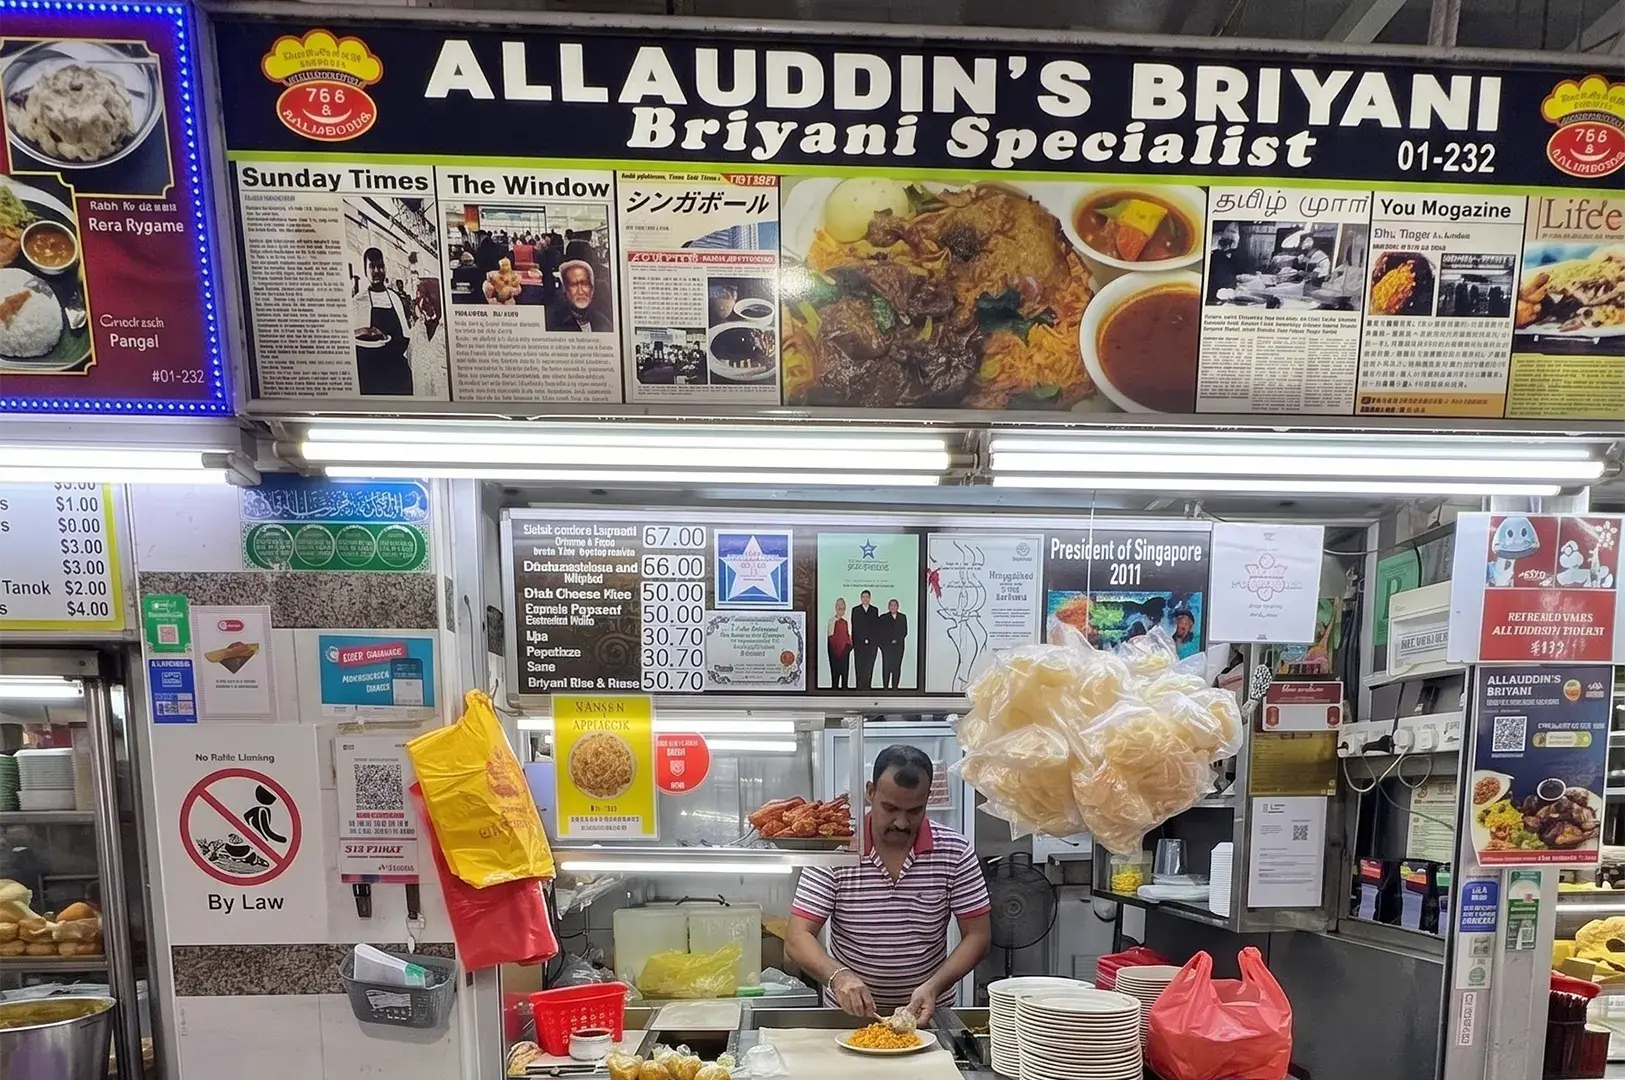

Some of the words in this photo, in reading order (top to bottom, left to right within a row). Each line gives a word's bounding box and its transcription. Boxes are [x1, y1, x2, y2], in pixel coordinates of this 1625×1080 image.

[424, 38, 1091, 119] ALLAUDDIN'S
[1131, 63, 1500, 131] BRIYANI
[628, 106, 919, 160] Briyani
[945, 115, 1317, 167] Specialist
[1398, 139, 1495, 172] 01-232
[242, 167, 342, 192] Sunday
[348, 169, 429, 191] Times
[447, 174, 496, 196] The
[502, 175, 611, 200] Window
[1380, 198, 1416, 217] You
[1421, 199, 1511, 221] Mogazine
[88, 217, 122, 232] Rera
[126, 218, 184, 235] Rygame
[152, 369, 204, 383] #01-232
[55, 496, 98, 512] $1.00
[58, 517, 100, 533] $0.00
[61, 538, 103, 554] $3.00
[644, 527, 704, 547] 67.00
[1050, 537, 1117, 562] President
[1118, 537, 1132, 562] of
[1132, 538, 1202, 567] Singapore
[63, 559, 105, 575] $3.00
[615, 563, 639, 573] and
[643, 556, 703, 577] 66.00
[1110, 562, 1141, 586] 2011
[65, 580, 107, 596] $2.00
[555, 588, 601, 600] Cheese
[642, 582, 704, 602] 50.00
[67, 600, 109, 617] $4.00
[642, 605, 703, 624] 50.00
[642, 627, 703, 647] 30.70
[642, 648, 703, 668] 30.70
[642, 671, 703, 690] 50.70
[1486, 674, 1562, 686] ALLAUDDIN'S
[1486, 686, 1532, 698] BRIYANI
[195, 754, 208, 762] No
[208, 894, 235, 914] By
[242, 894, 284, 910] Law
